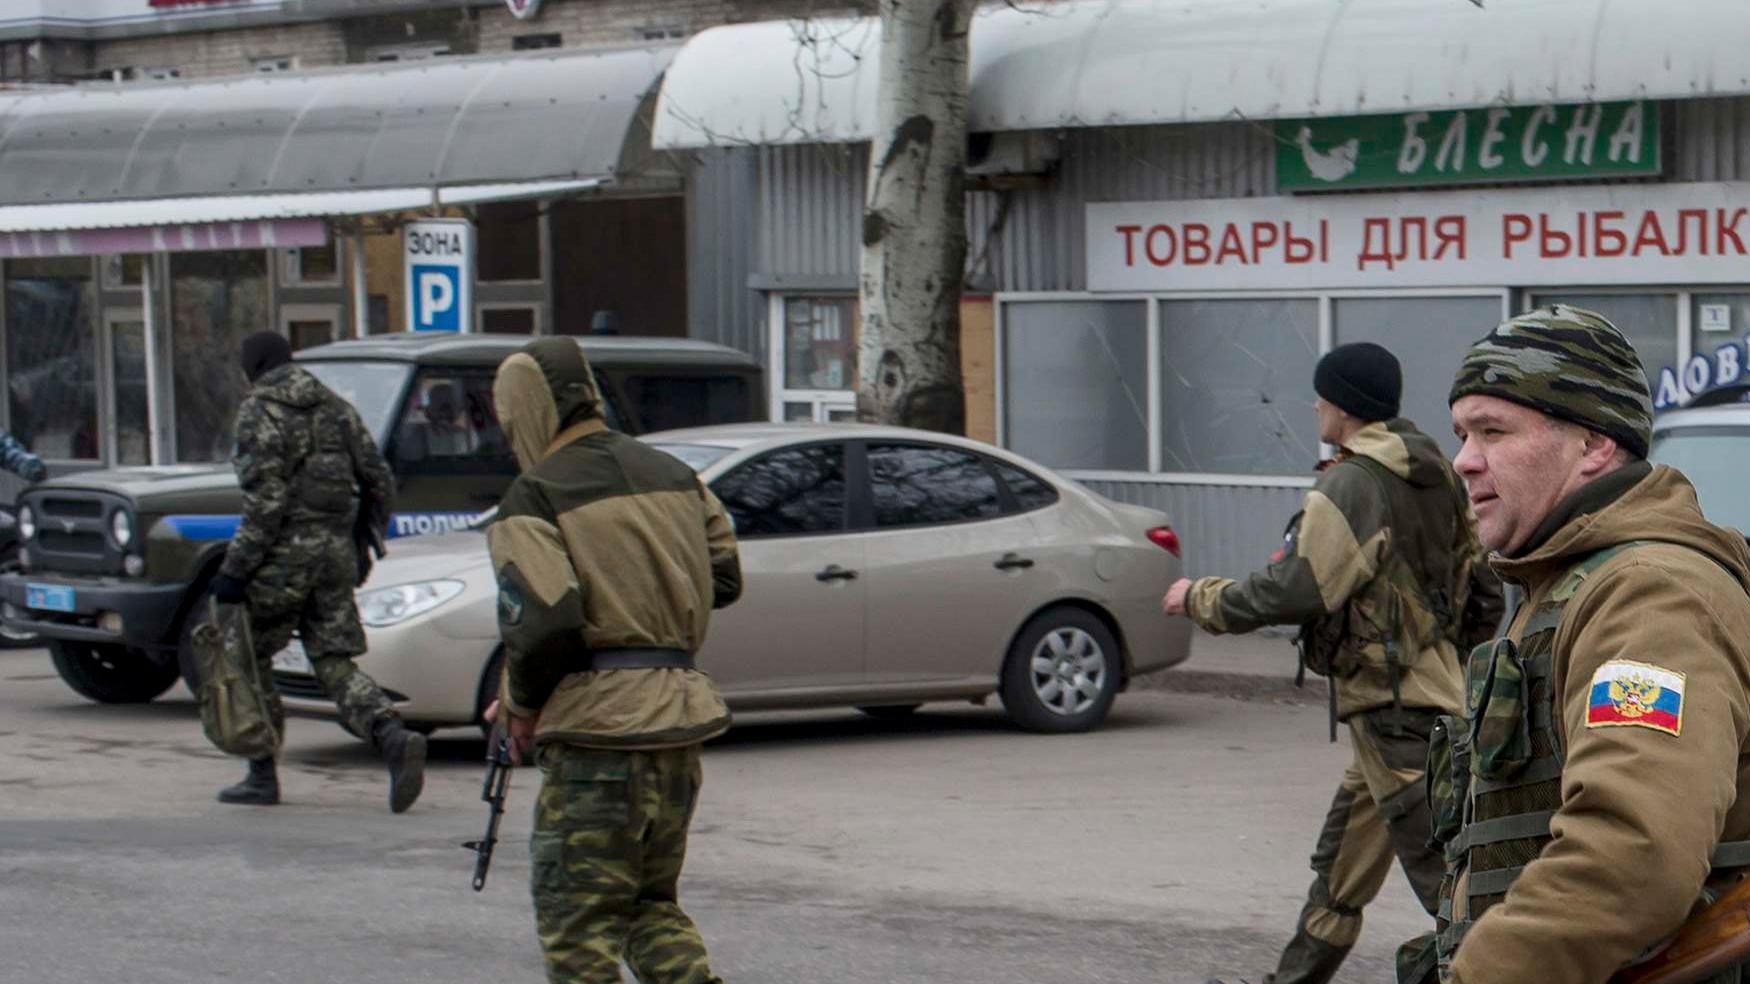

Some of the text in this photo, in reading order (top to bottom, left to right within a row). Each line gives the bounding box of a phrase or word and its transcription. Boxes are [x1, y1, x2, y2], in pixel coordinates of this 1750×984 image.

[1397, 99, 1643, 173] БЛЕСНА
[408, 231, 462, 255] ЗОНА
[1115, 219, 1328, 267] ТОВАРЫ
[1357, 215, 1467, 271] ДЛЯ
[420, 271, 454, 326] P
